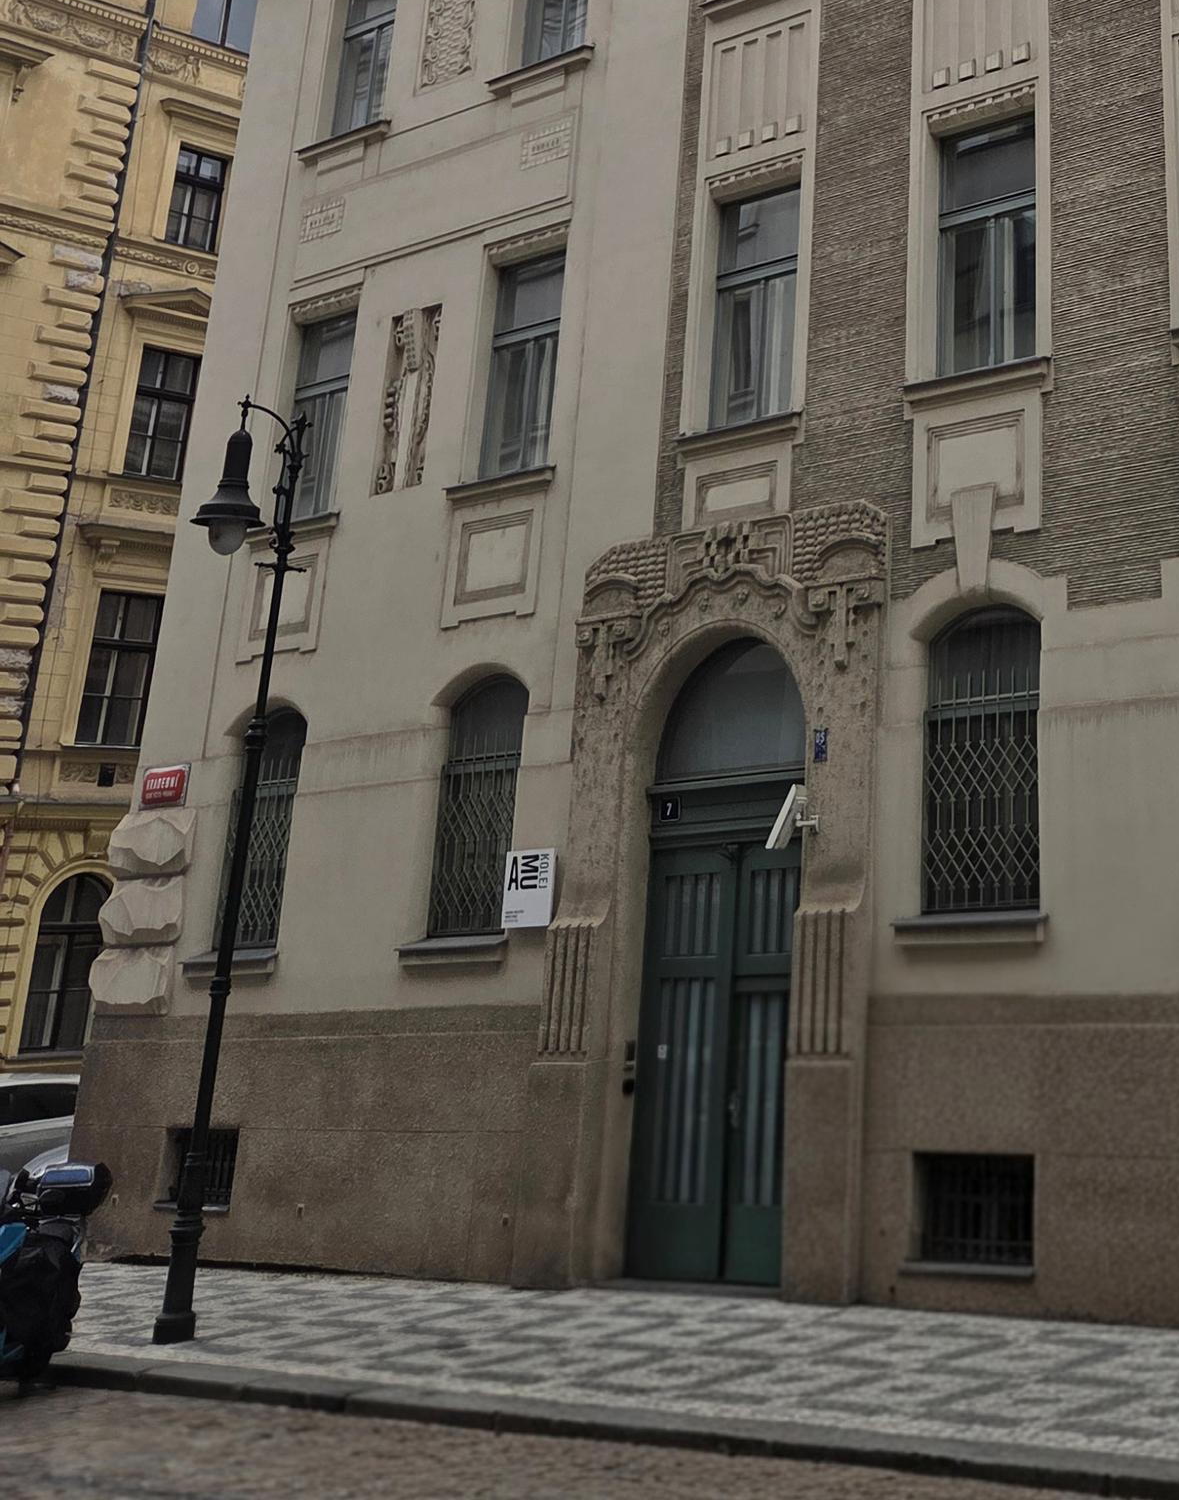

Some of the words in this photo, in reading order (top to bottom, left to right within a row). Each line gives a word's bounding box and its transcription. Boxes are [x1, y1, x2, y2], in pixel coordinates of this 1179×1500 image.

[666, 802, 672, 816] 7
[508, 854, 539, 891] AMU
[538, 853, 550, 889] KOLEJ
